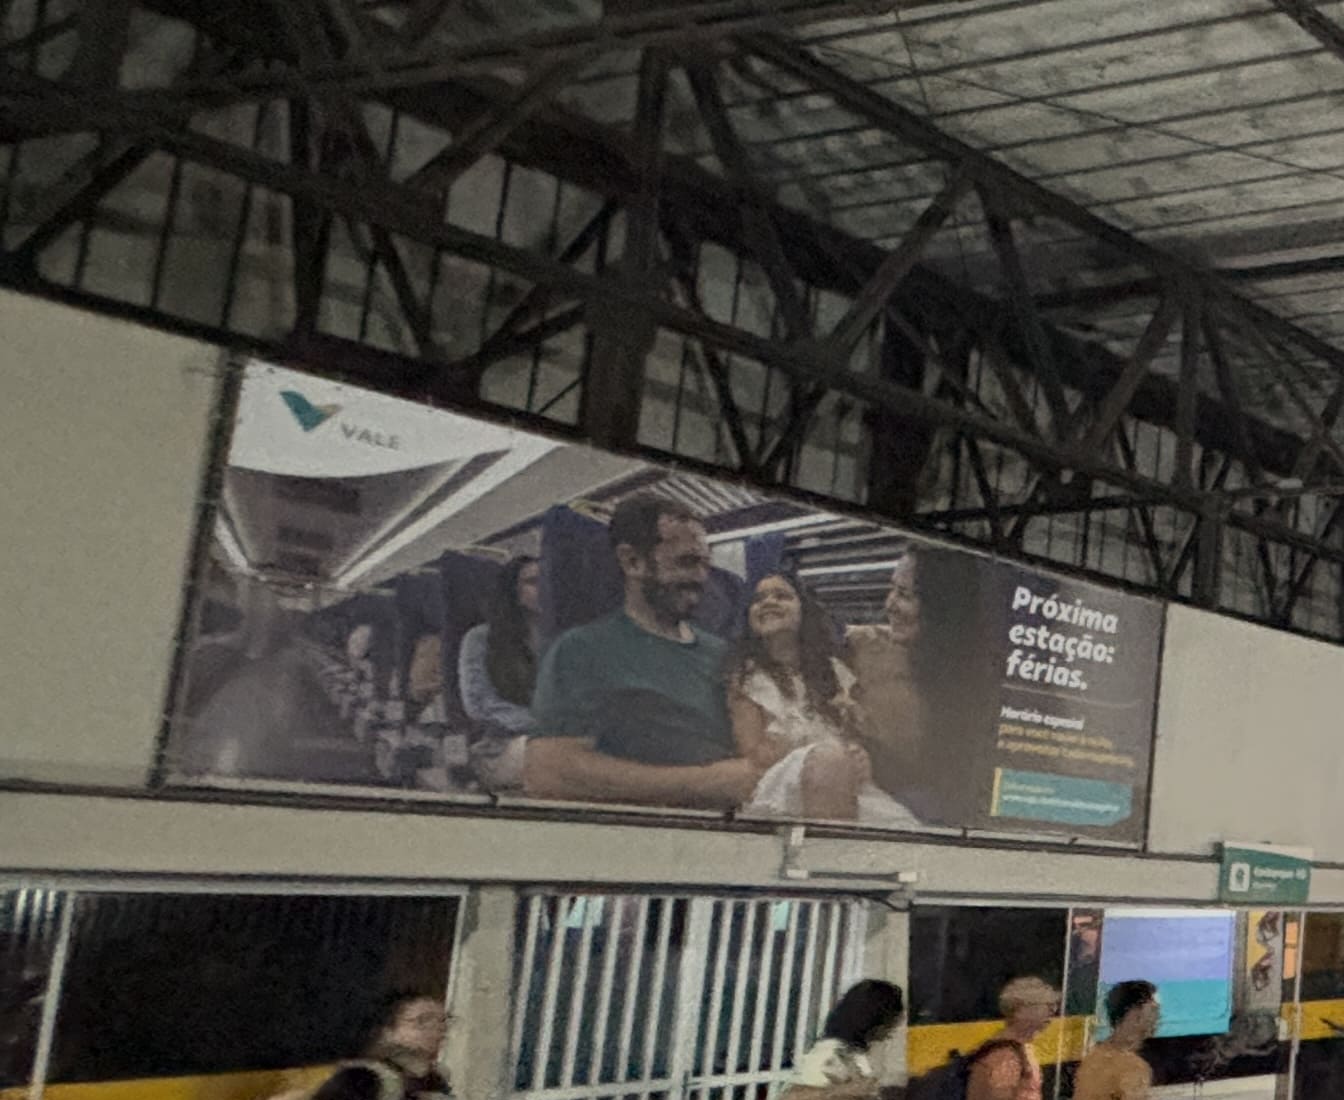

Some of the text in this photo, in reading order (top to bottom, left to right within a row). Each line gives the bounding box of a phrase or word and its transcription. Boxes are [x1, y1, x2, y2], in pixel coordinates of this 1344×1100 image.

[340, 422, 400, 449] VALE
[1011, 586, 1119, 634] Próxima
[1008, 624, 1115, 663] estação:
[1005, 650, 1088, 690] férias.
